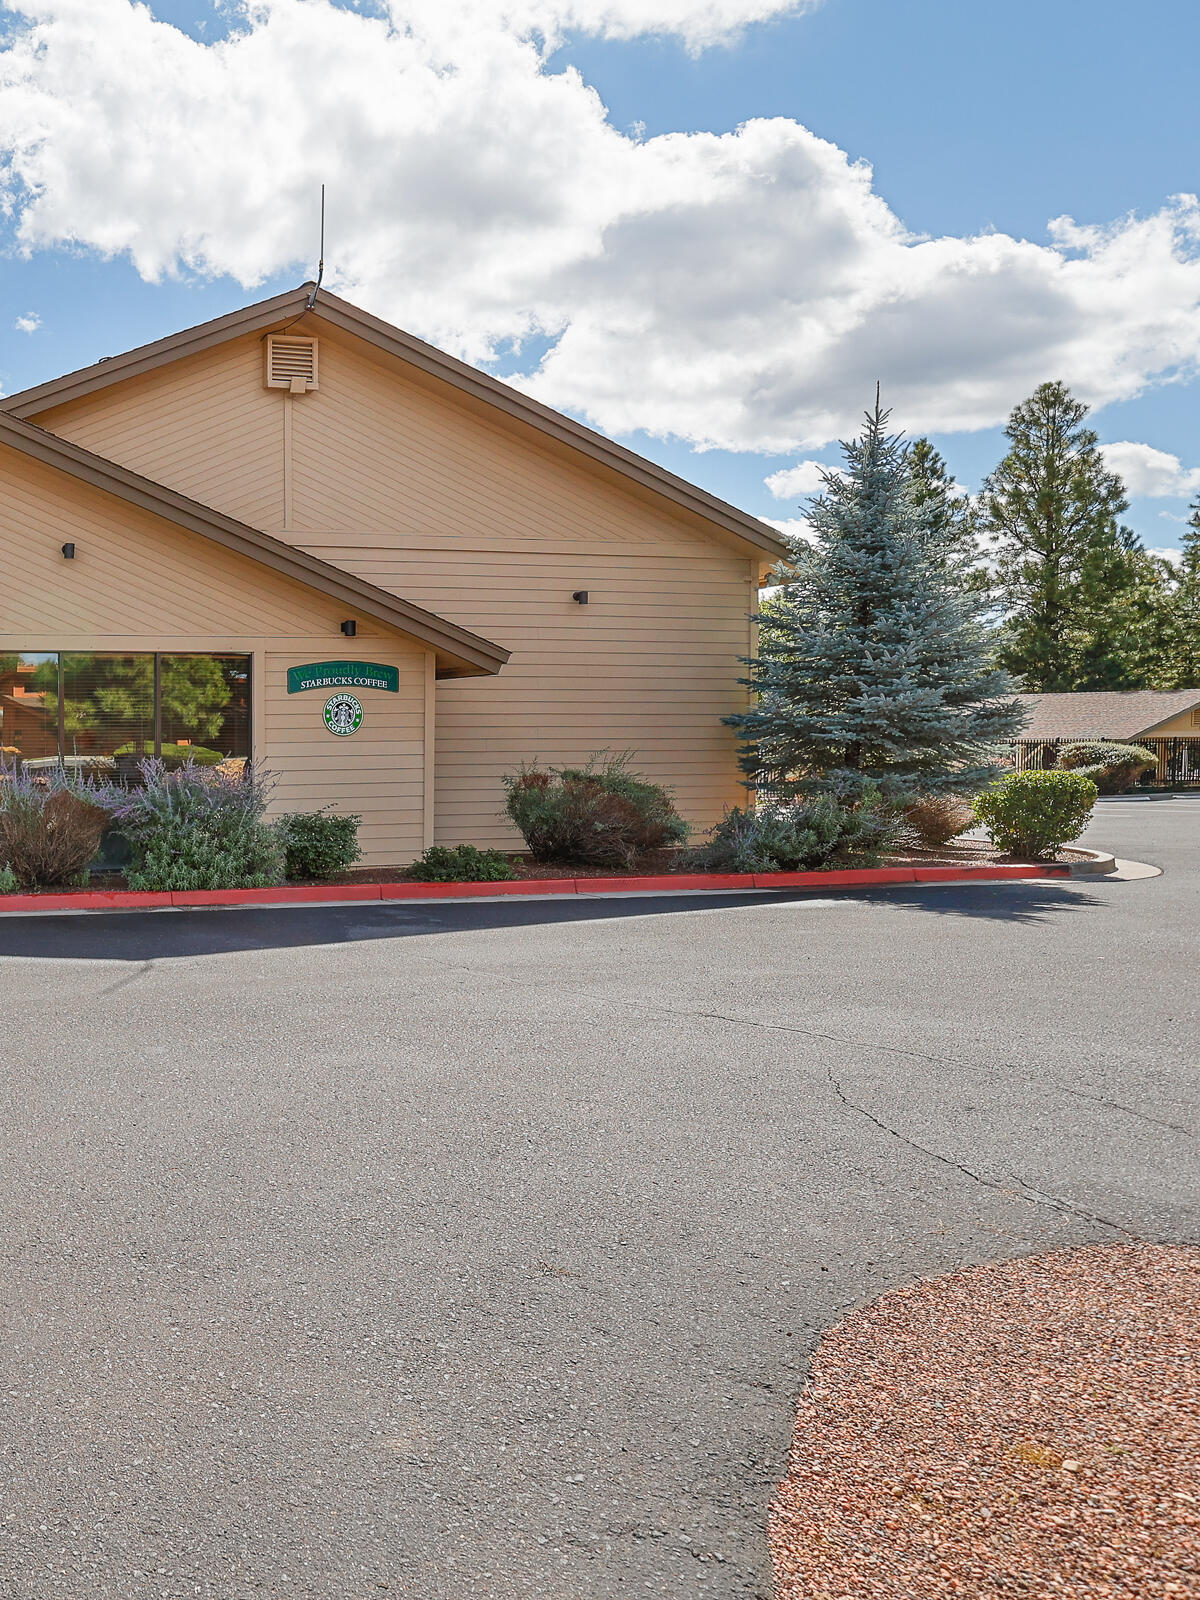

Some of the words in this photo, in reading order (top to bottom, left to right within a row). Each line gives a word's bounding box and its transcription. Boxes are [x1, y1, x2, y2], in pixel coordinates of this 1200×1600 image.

[293, 669, 310, 680] We
[315, 664, 360, 678] Proudly
[366, 665, 393, 680] Brew
[300, 677, 353, 689] STARBUCKS
[353, 677, 388, 689] COFFEE
[326, 694, 361, 715] STARBUCKS
[328, 720, 356, 734] COFFEE
